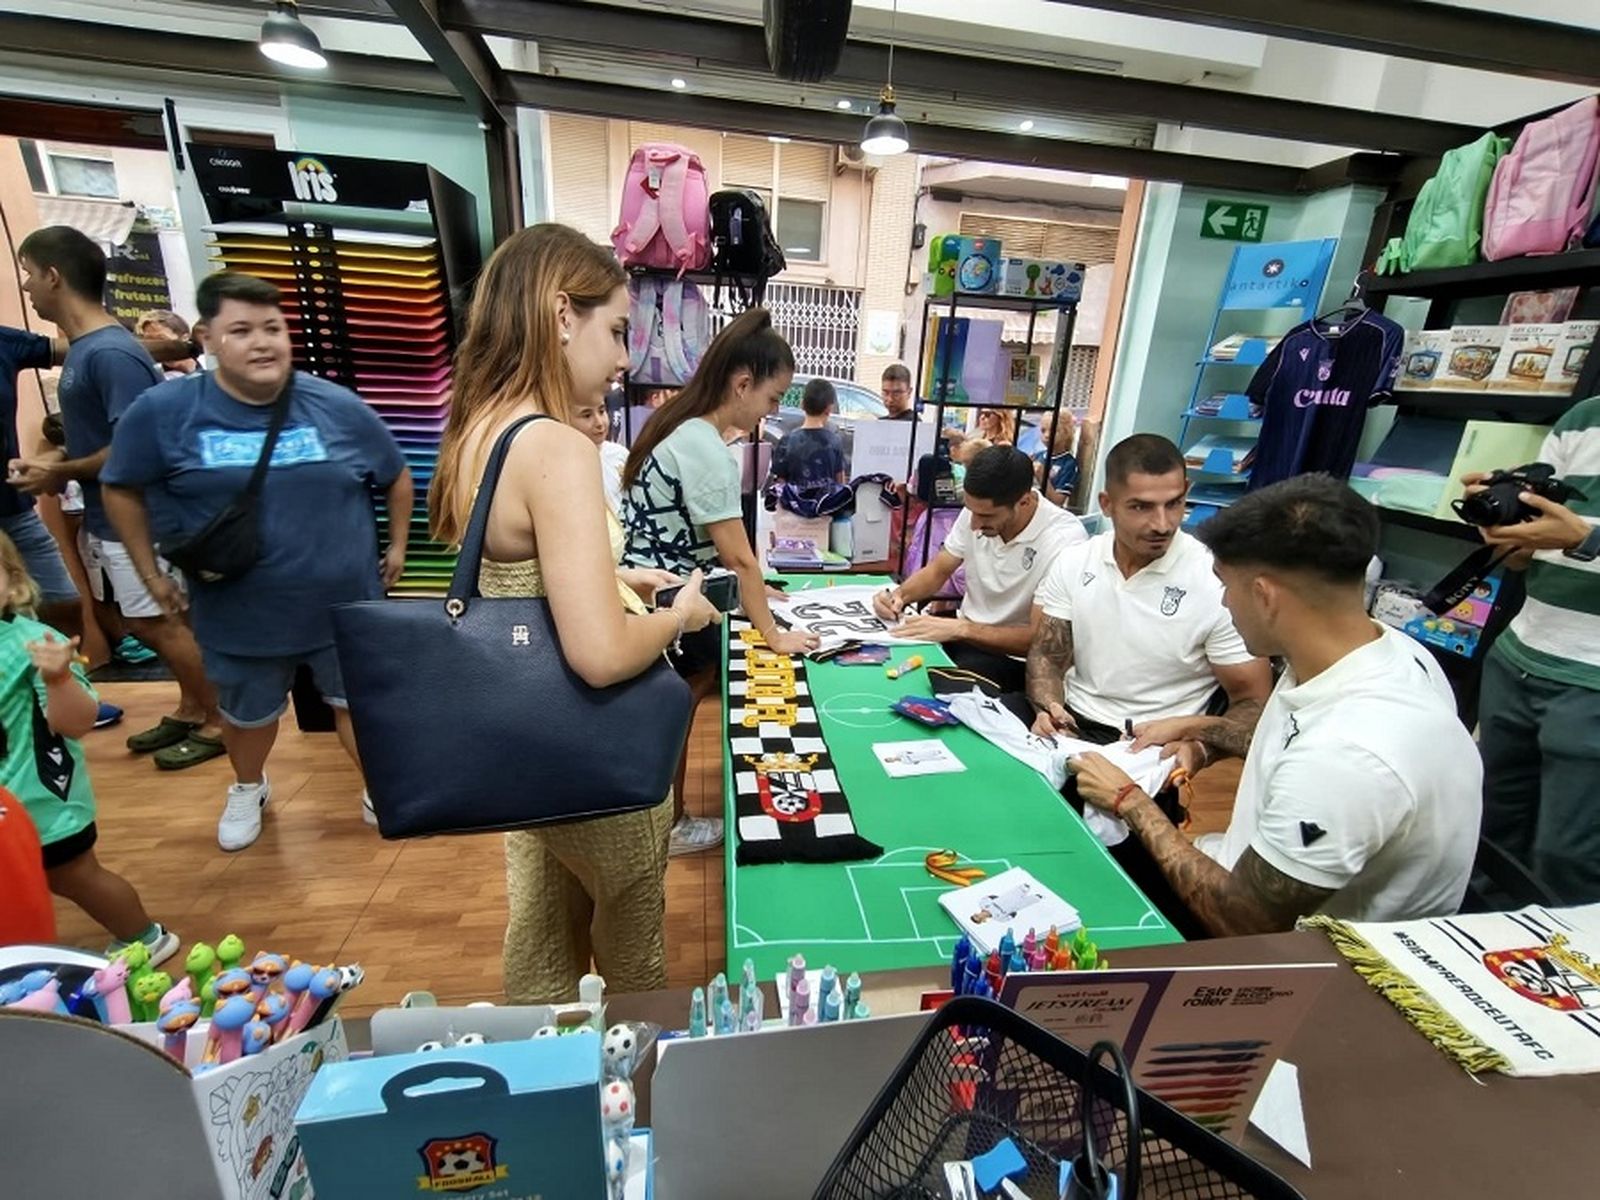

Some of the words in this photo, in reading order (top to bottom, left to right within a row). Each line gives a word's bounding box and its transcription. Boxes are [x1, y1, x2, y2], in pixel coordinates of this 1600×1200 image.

[287, 160, 339, 203] Iris
[1194, 986, 1232, 998] Este
[1025, 998, 1134, 1011] JETSTREAM
[1182, 997, 1230, 1007] roller
